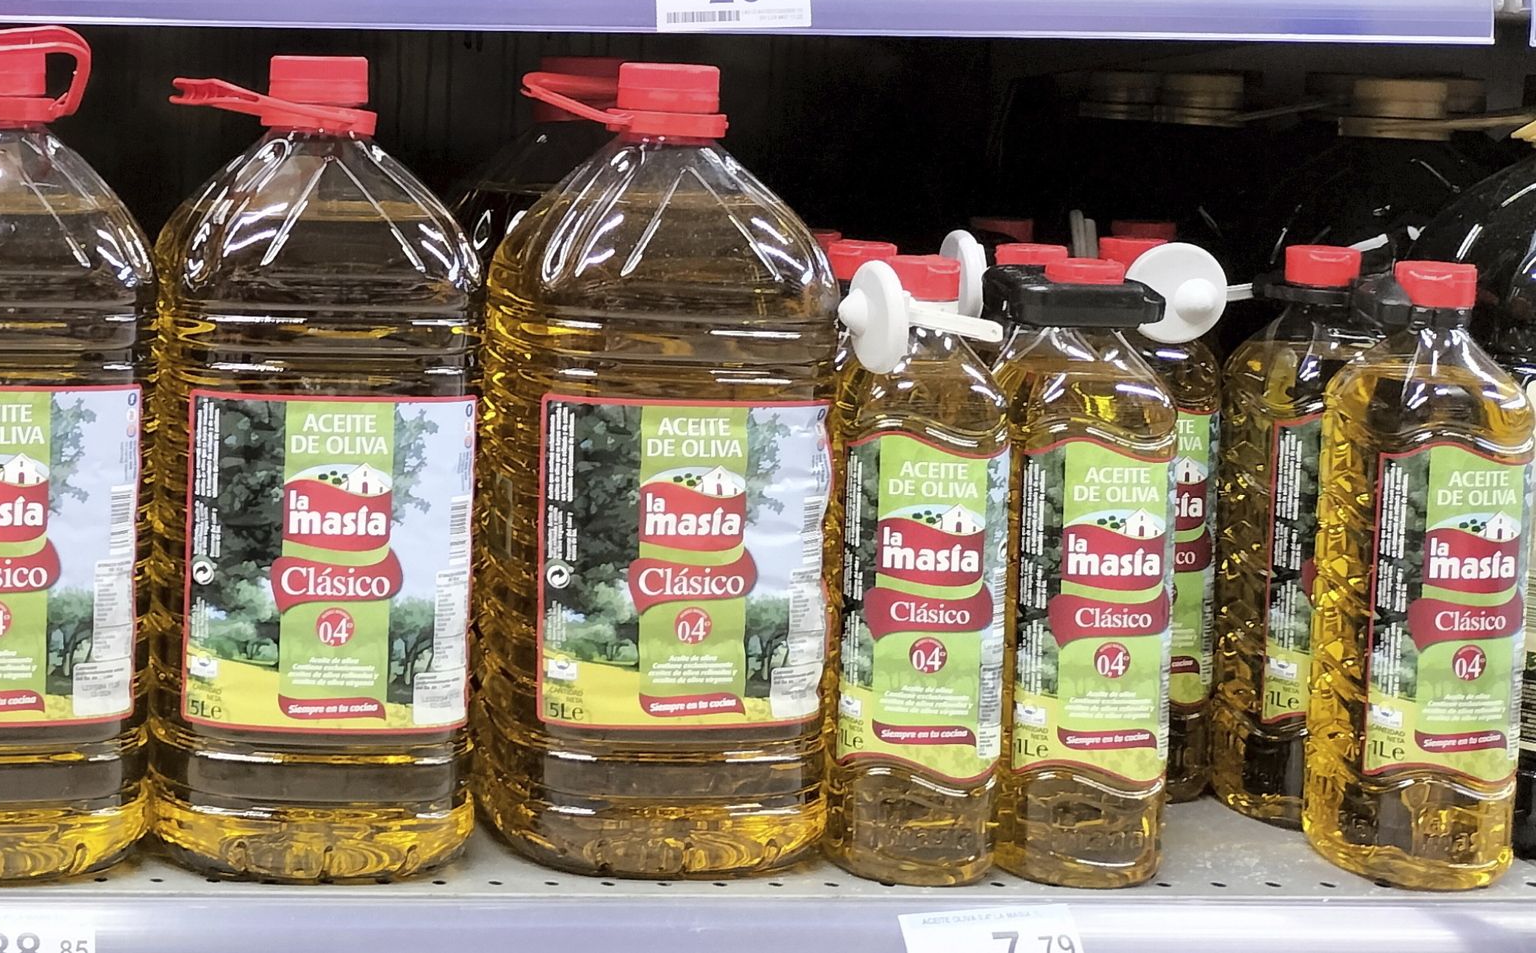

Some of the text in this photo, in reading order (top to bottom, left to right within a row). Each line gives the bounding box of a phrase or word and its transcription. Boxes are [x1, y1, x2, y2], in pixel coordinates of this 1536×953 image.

[302, 413, 377, 433] ACEITE
[291, 436, 389, 455] DE OLIVA
[899, 461, 968, 479] ACEITE
[289, 489, 309, 510] la
[888, 479, 979, 500] DE OLIVA
[645, 492, 665, 513] la
[289, 504, 387, 536] masía
[645, 507, 741, 537] masía
[883, 526, 902, 546] la
[1068, 533, 1088, 553] la
[1430, 537, 1449, 555] la
[882, 542, 980, 574] masía
[1068, 549, 1161, 577] masía
[1429, 552, 1516, 579] masía
[281, 566, 391, 597] Clásico
[637, 567, 745, 597] Clásico
[890, 600, 971, 625] Clásico
[1074, 607, 1152, 630] Clásico
[1435, 611, 1507, 634] Clásico
